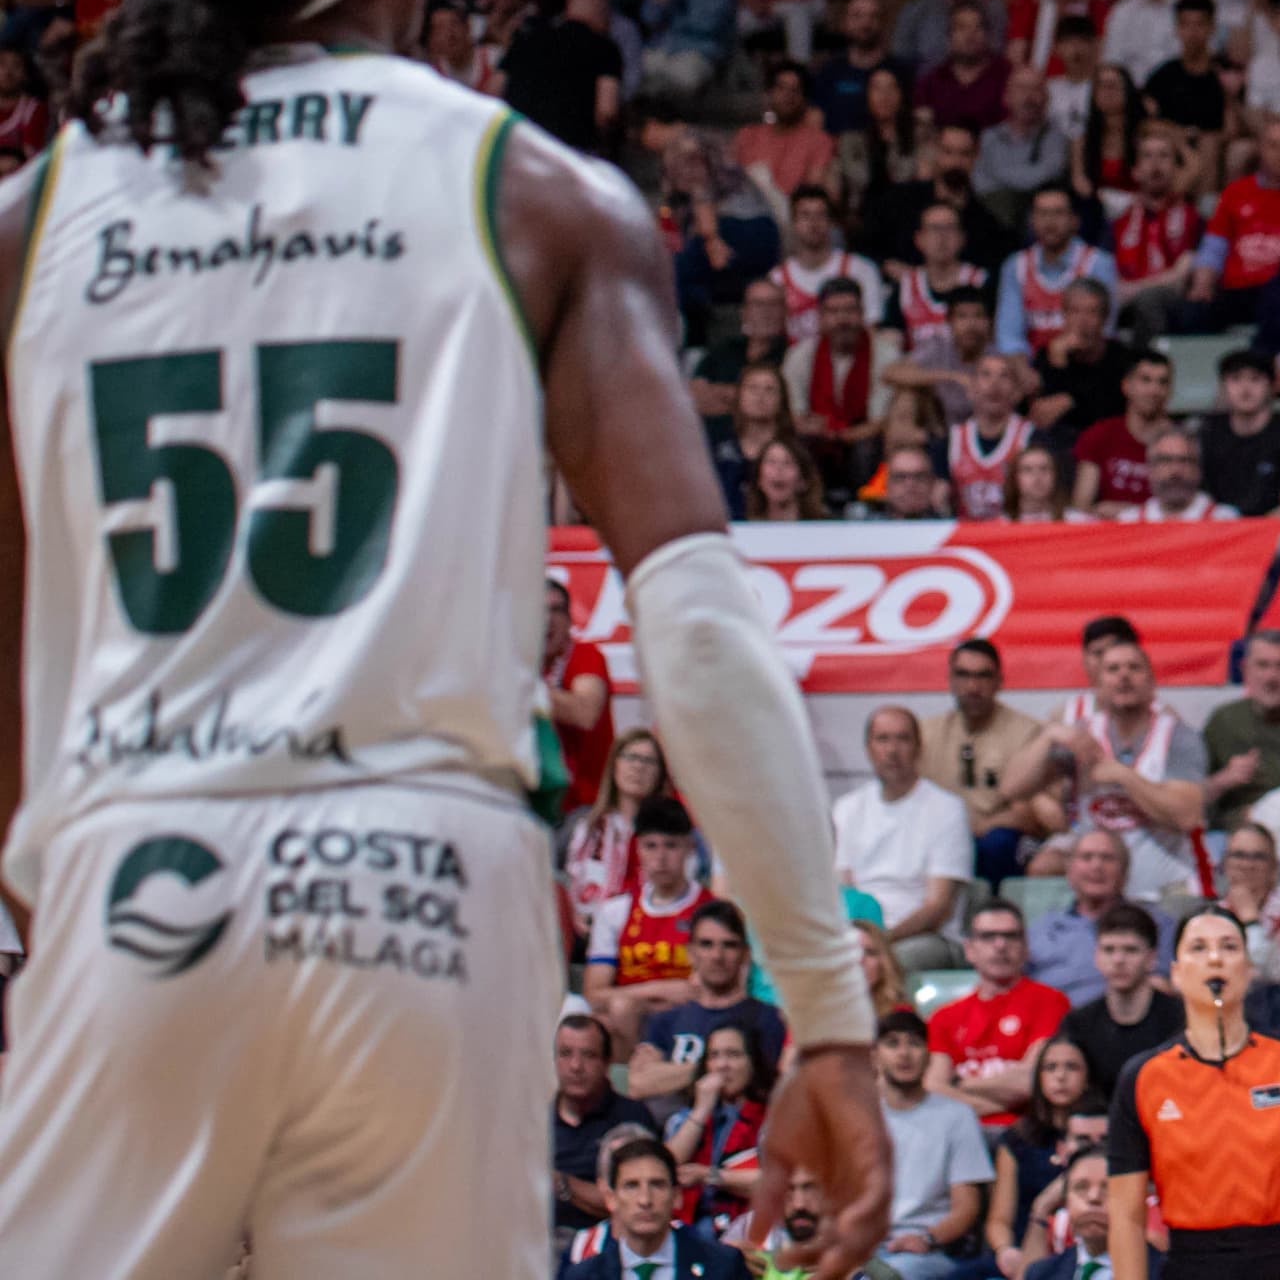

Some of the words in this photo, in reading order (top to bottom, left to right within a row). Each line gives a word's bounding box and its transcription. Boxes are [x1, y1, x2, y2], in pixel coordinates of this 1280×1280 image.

[88, 337, 402, 637] 55
[267, 826, 469, 890] COSTA
[266, 879, 367, 919] DEL
[381, 880, 470, 939] SOL
